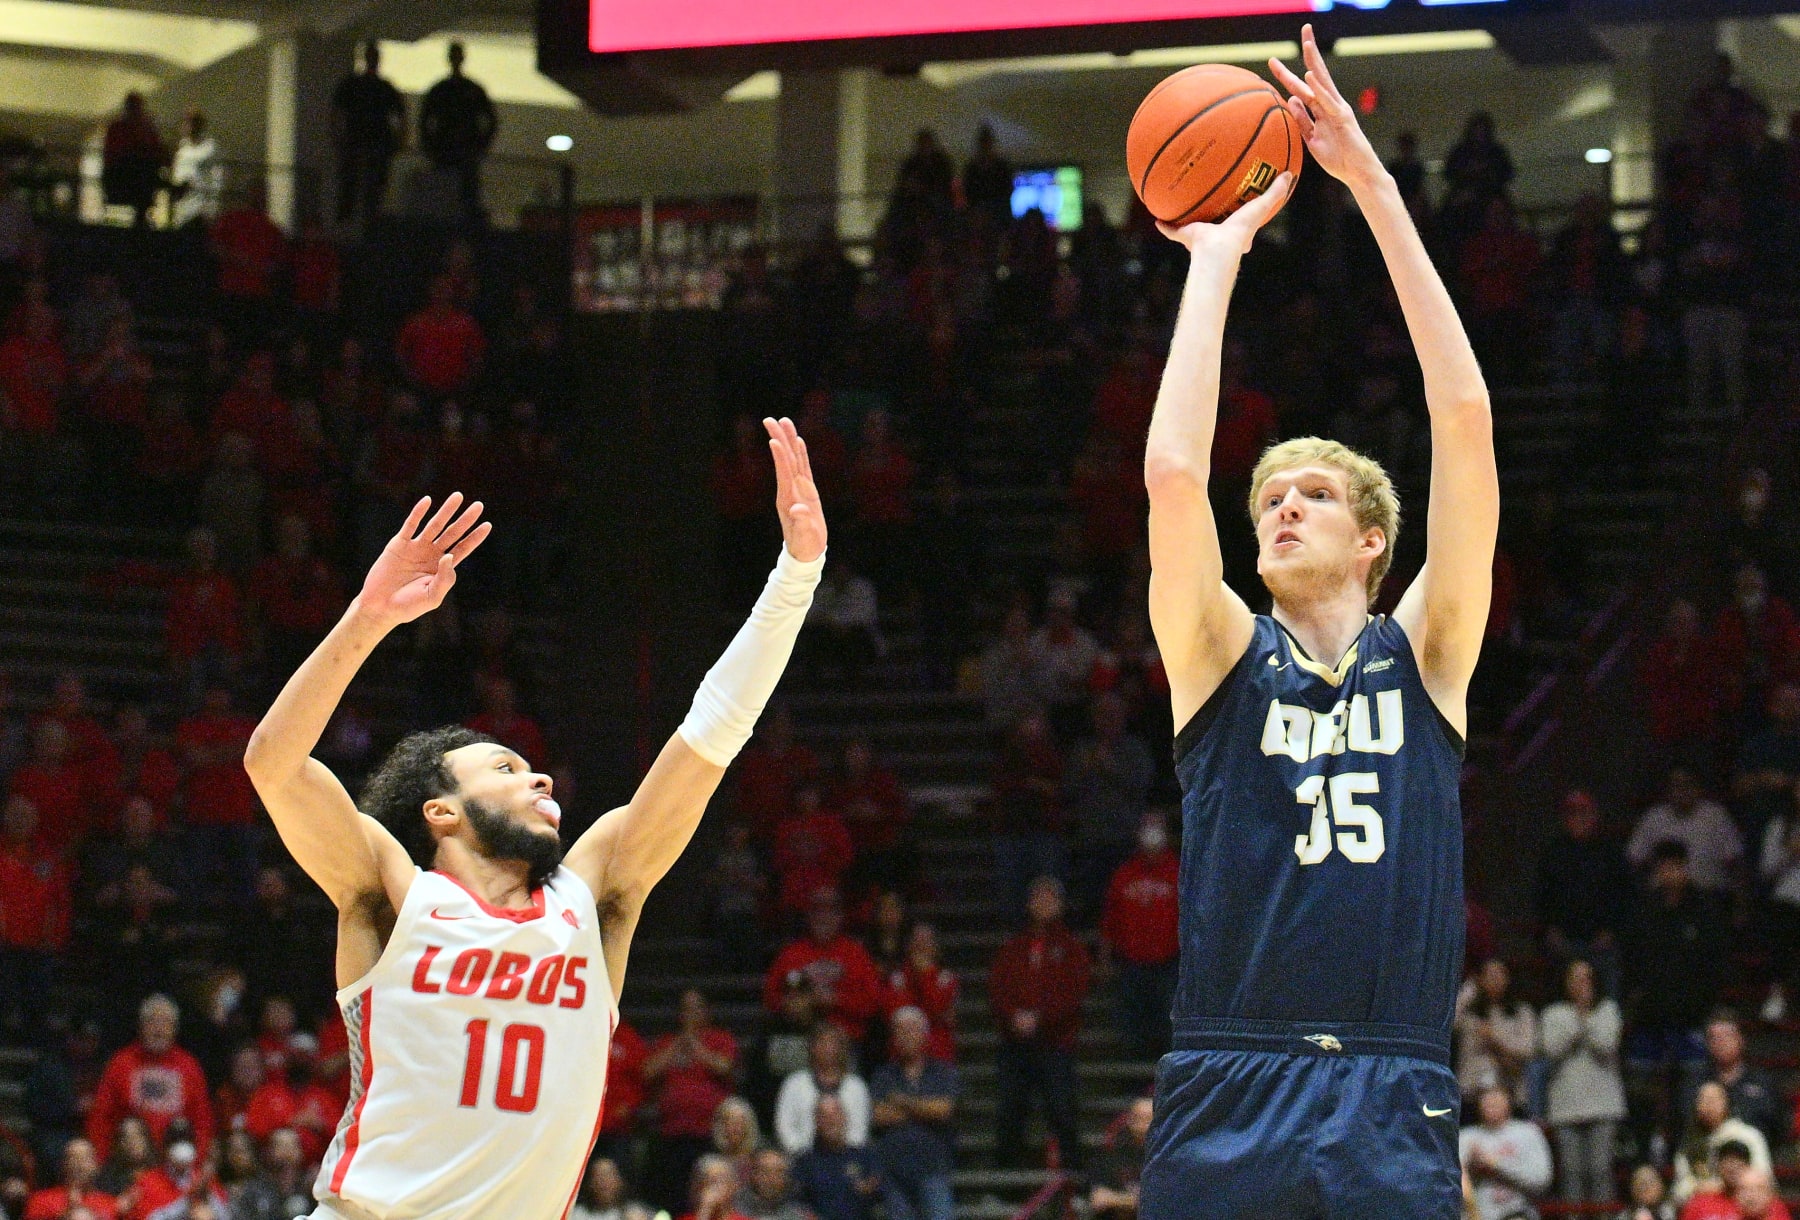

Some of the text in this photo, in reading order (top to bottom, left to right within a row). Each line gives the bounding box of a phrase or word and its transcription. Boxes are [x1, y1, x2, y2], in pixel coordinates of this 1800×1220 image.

[1294, 771, 1386, 866] 35
[411, 945, 588, 1010] LOBOS
[458, 1017, 546, 1115] 10
